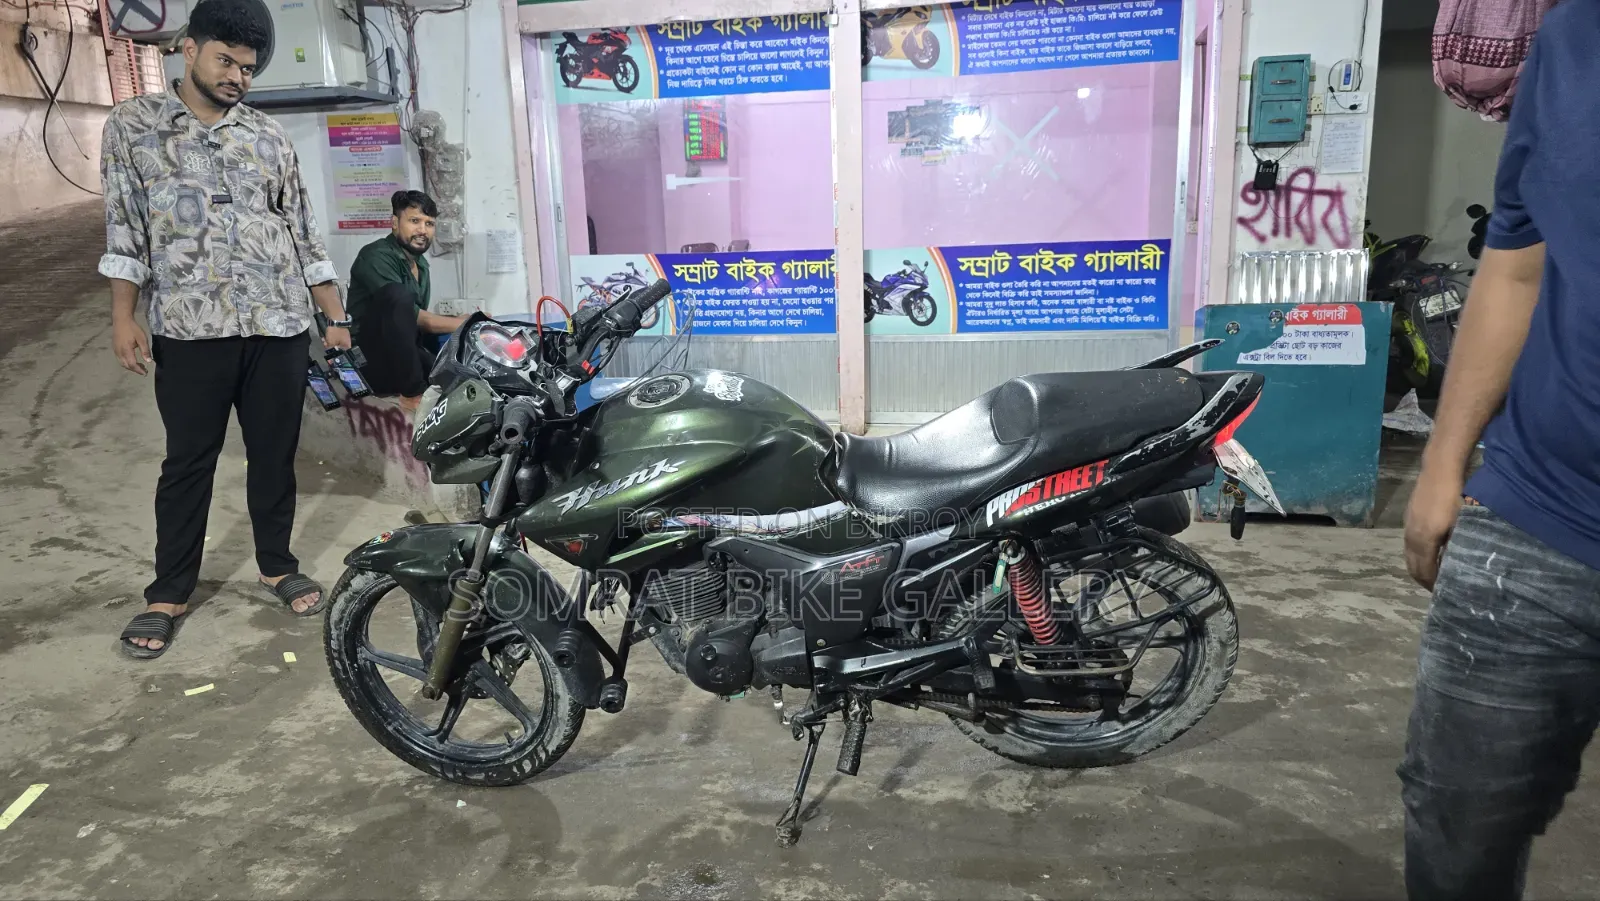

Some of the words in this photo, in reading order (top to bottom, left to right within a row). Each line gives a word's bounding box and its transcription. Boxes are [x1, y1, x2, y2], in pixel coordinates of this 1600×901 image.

[790, 36, 808, 46] বাইক
[810, 34, 830, 44] কিনবে
[957, 250, 1012, 278] সম্রাট
[1017, 248, 1077, 275] বাইক
[1084, 244, 1165, 272] গ্যালারী
[672, 258, 720, 284] সম্রাট
[724, 256, 776, 282] বাইক
[820, 286, 836, 294] ১০০
[704, 298, 720, 306] বাইক
[1312, 306, 1348, 320] গ্যালারী
[1294, 330, 1310, 338] টাকা
[1292, 341, 1306, 350] ছোট
[1308, 342, 1318, 350] বড়
[1320, 342, 1342, 350] কাজের
[1264, 352, 1275, 360] বিল
[1278, 352, 1292, 360] দিতে
[552, 458, 685, 515] Hunk
